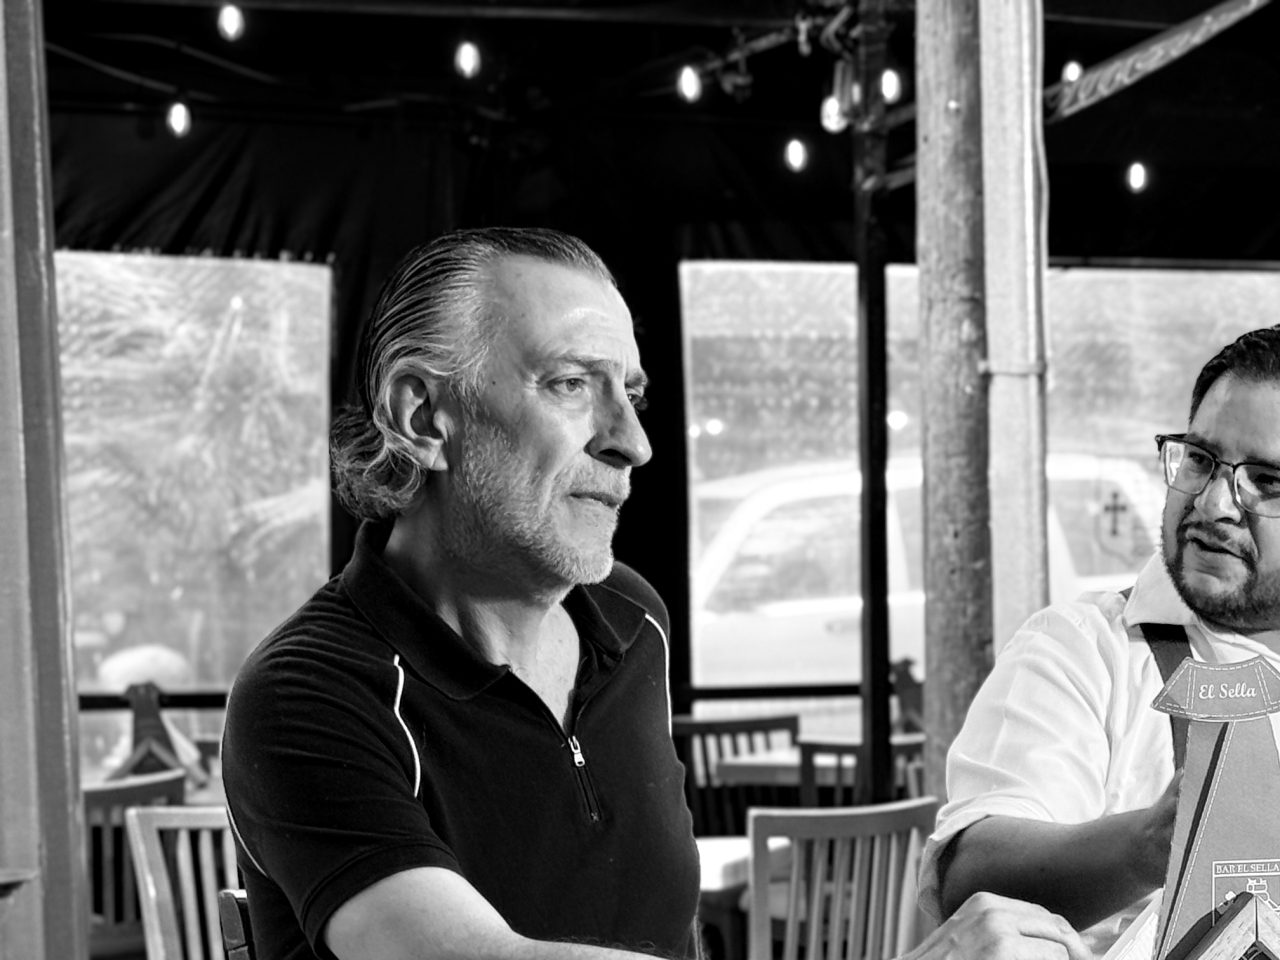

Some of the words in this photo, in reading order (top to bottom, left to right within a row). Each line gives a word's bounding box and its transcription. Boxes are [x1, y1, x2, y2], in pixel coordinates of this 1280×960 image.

[1199, 684, 1215, 699] El
[1219, 683, 1257, 698] Sella
[1216, 865, 1236, 873] BAR
[1237, 864, 1250, 872] EL
[1250, 863, 1280, 873] SELLA
